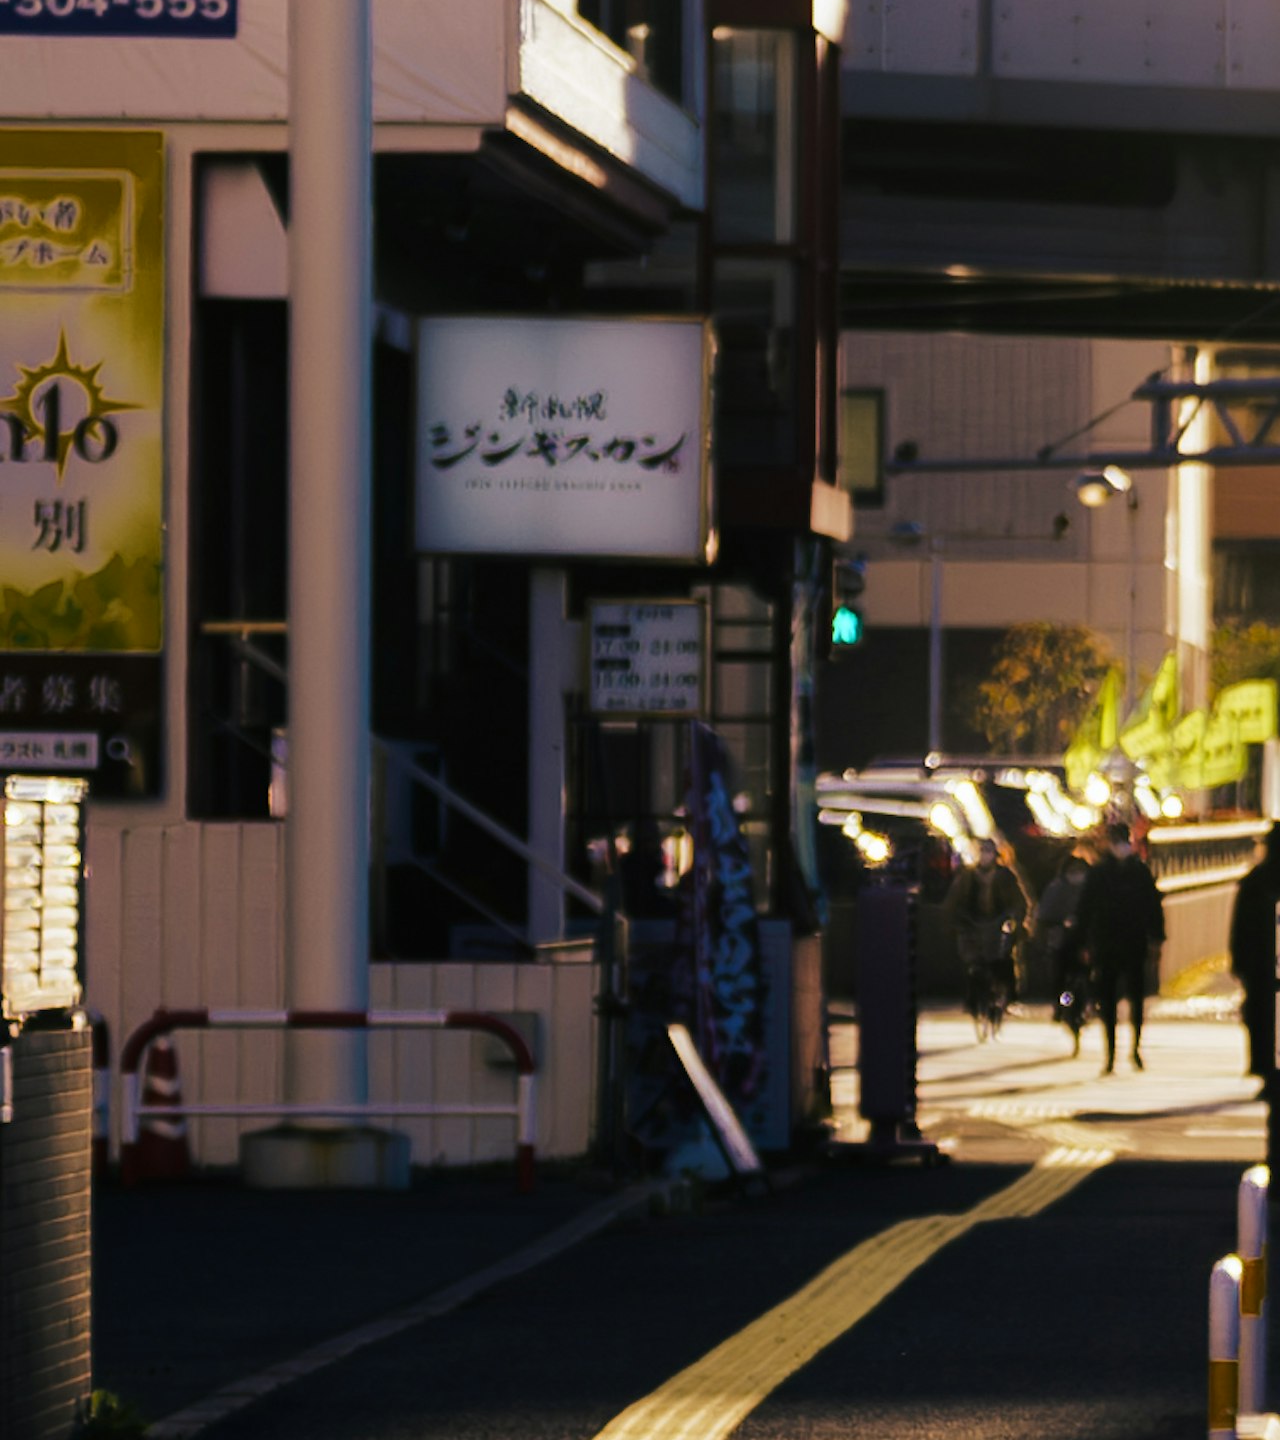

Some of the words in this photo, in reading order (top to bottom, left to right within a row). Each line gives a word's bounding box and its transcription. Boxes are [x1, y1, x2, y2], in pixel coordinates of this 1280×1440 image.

[429, 420, 689, 471] ジンギスカン
